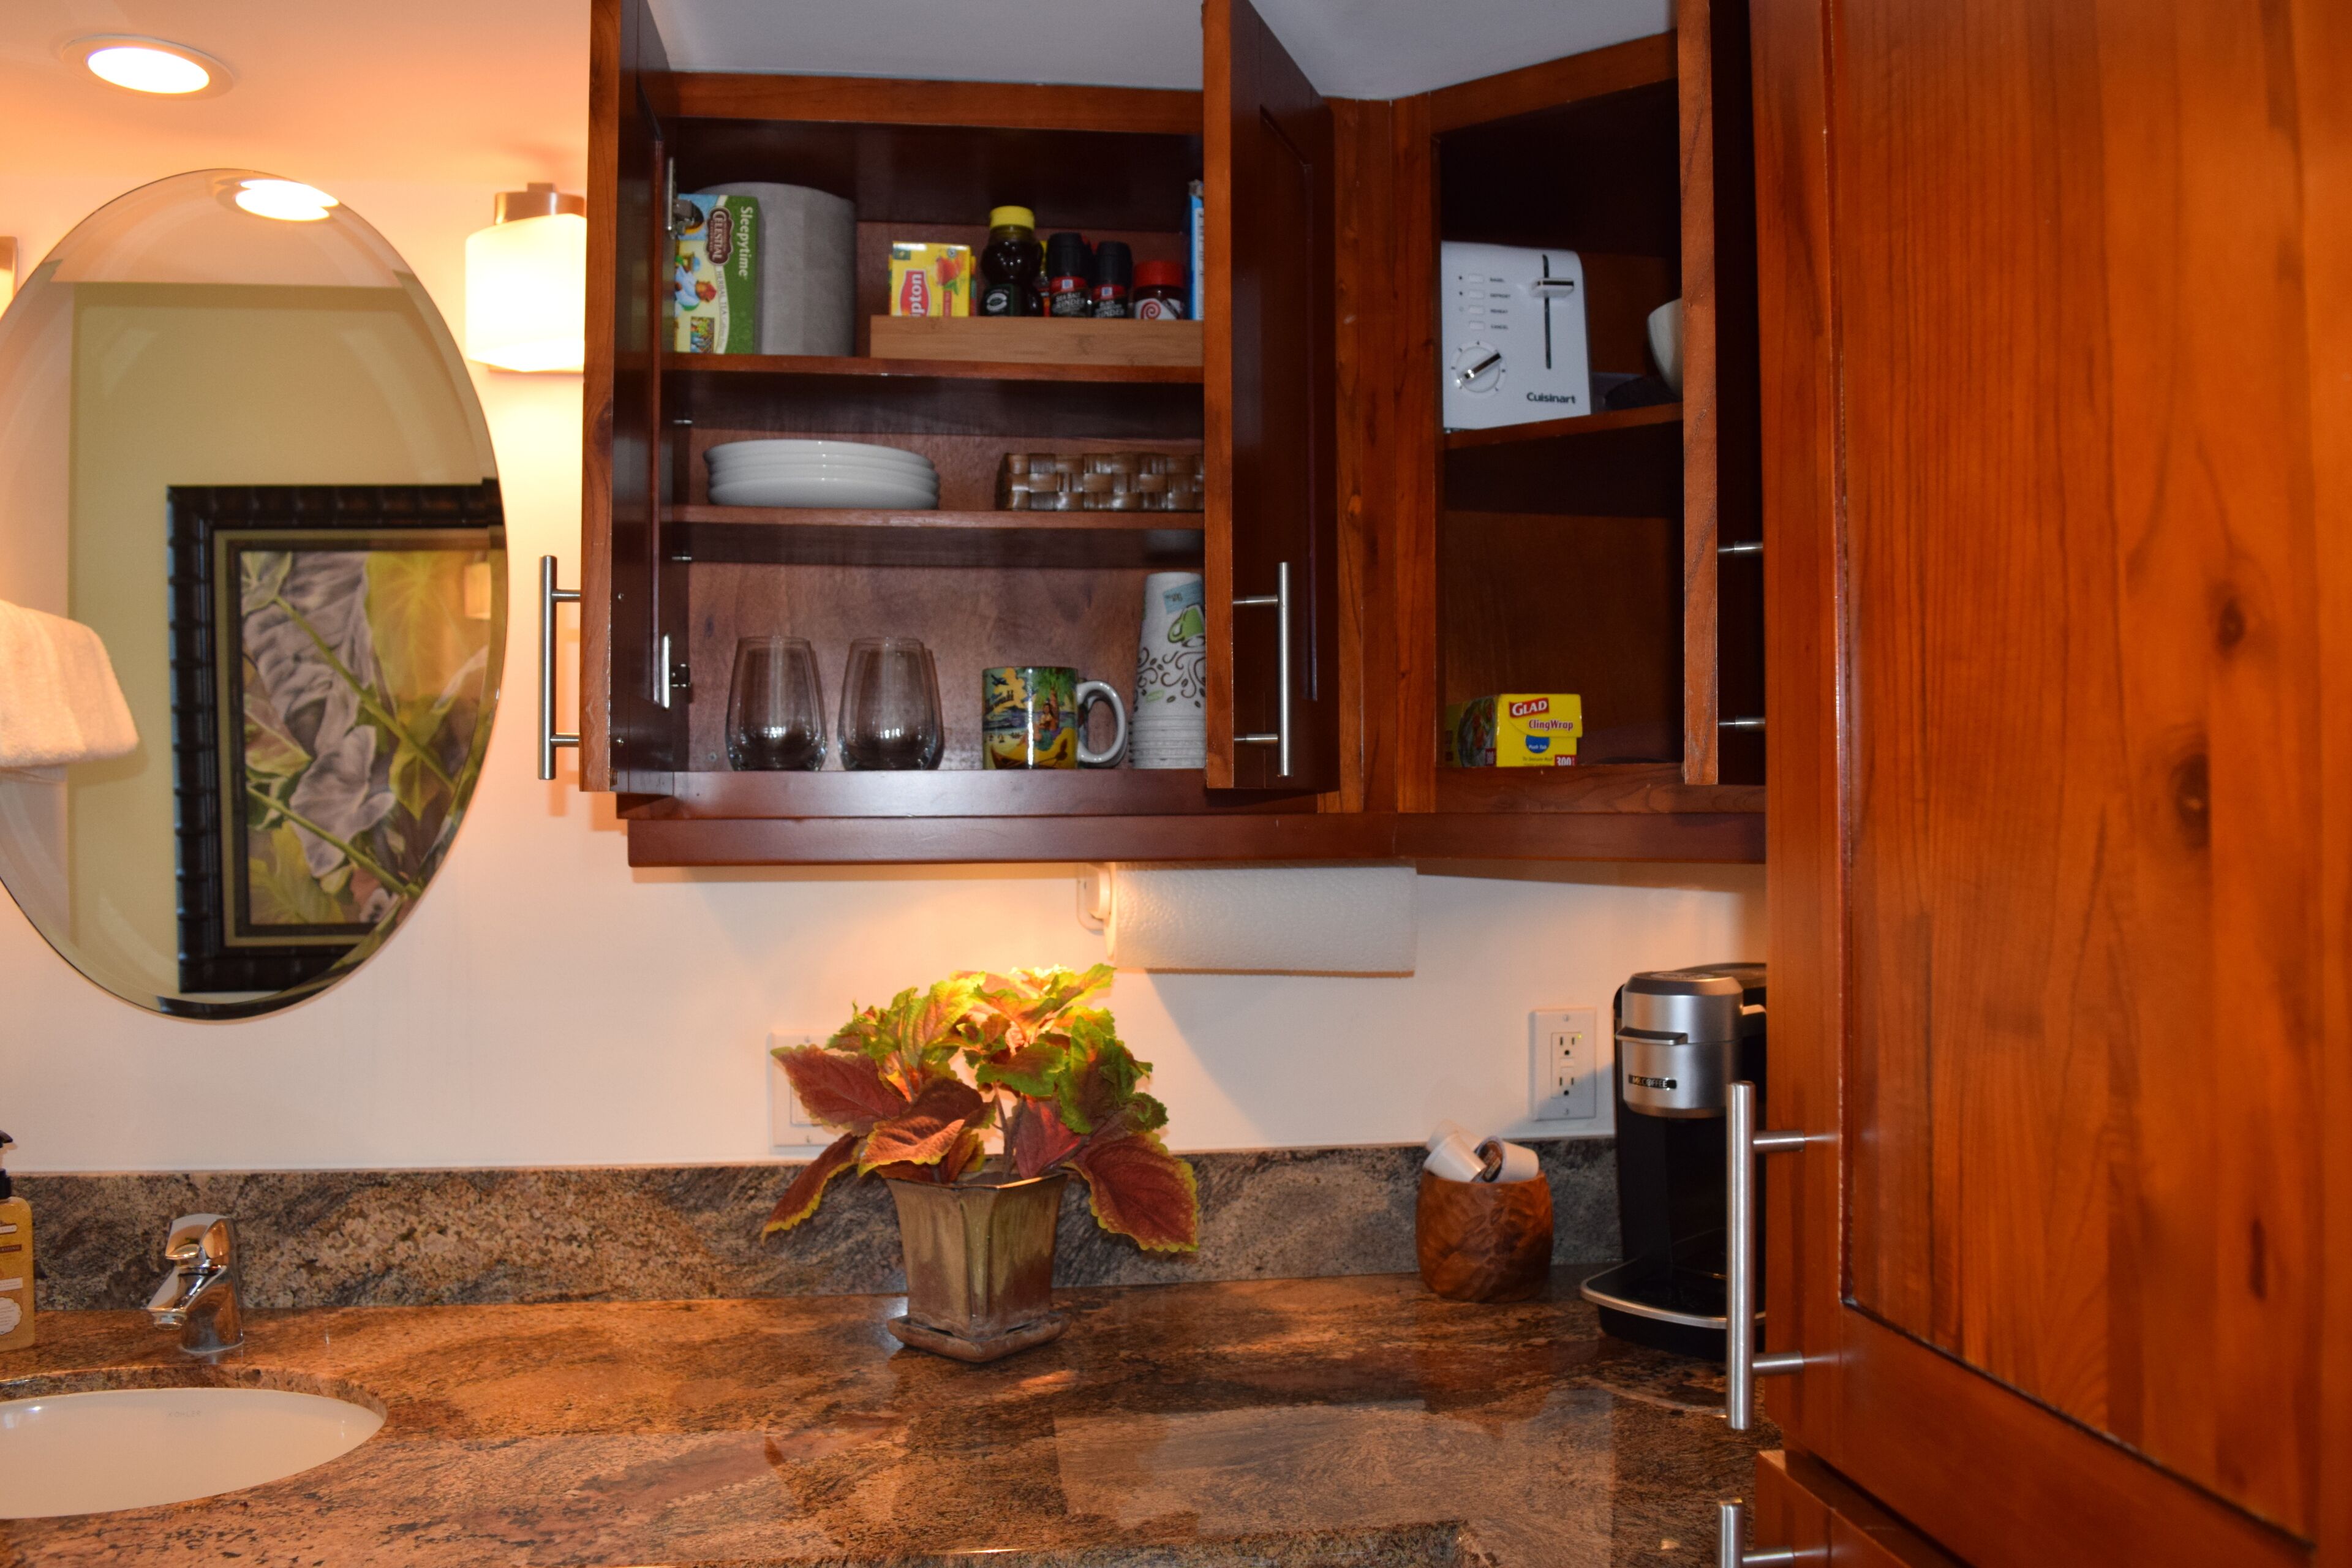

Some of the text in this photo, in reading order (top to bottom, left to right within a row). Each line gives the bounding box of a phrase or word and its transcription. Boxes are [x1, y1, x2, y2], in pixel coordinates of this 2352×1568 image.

[712, 211, 727, 260] CELESTIAL
[737, 206, 753, 277] Sleepytime
[910, 274, 925, 317] pton
[1526, 392, 1576, 404] Cuisinart
[1512, 701, 1547, 716] GLAD
[1529, 719, 1574, 731] ClingWrap
